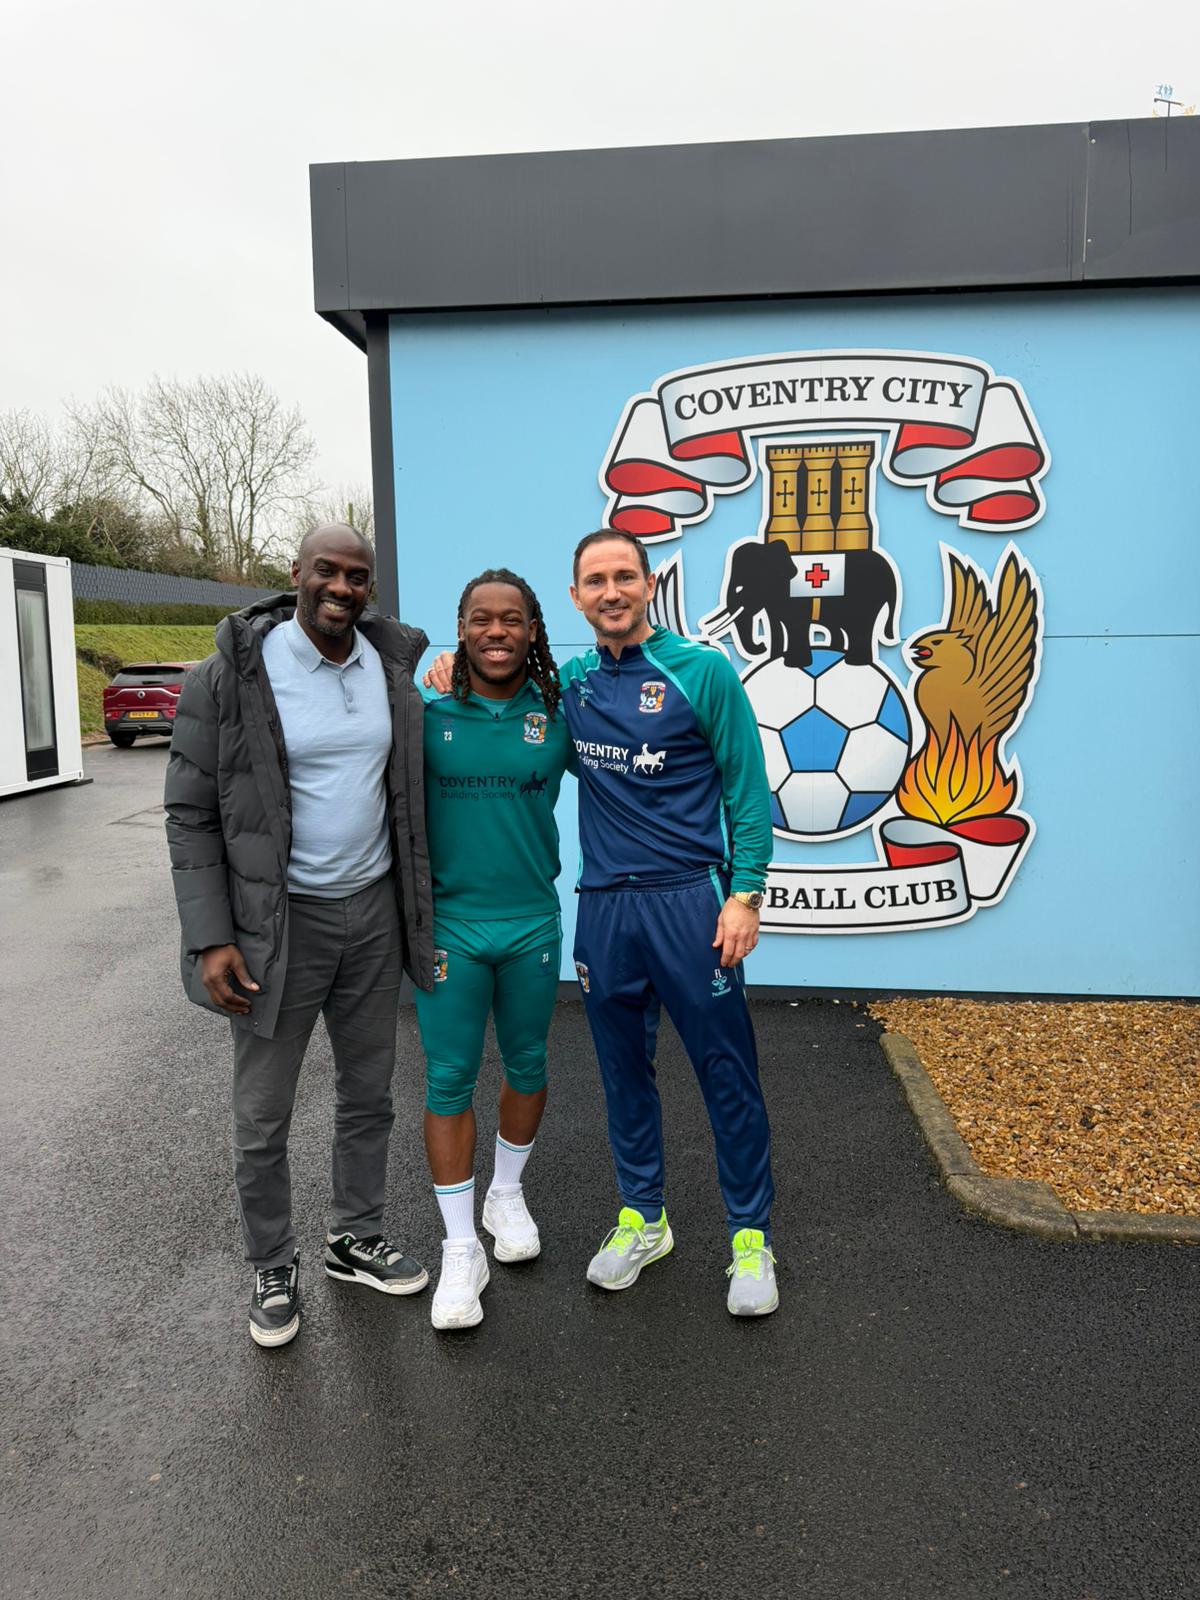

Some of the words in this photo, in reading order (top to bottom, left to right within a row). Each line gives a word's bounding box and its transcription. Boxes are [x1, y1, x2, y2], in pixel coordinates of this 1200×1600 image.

[674, 376, 875, 421] COVENTRY
[881, 376, 973, 409] CITY
[573, 739, 630, 761] OVENTRY
[600, 759, 629, 775] Society
[439, 776, 517, 788] COVENTRY
[440, 789, 479, 801] Building
[482, 789, 516, 801] Society
[762, 886, 857, 910] BALL
[864, 878, 958, 908] CLUB
